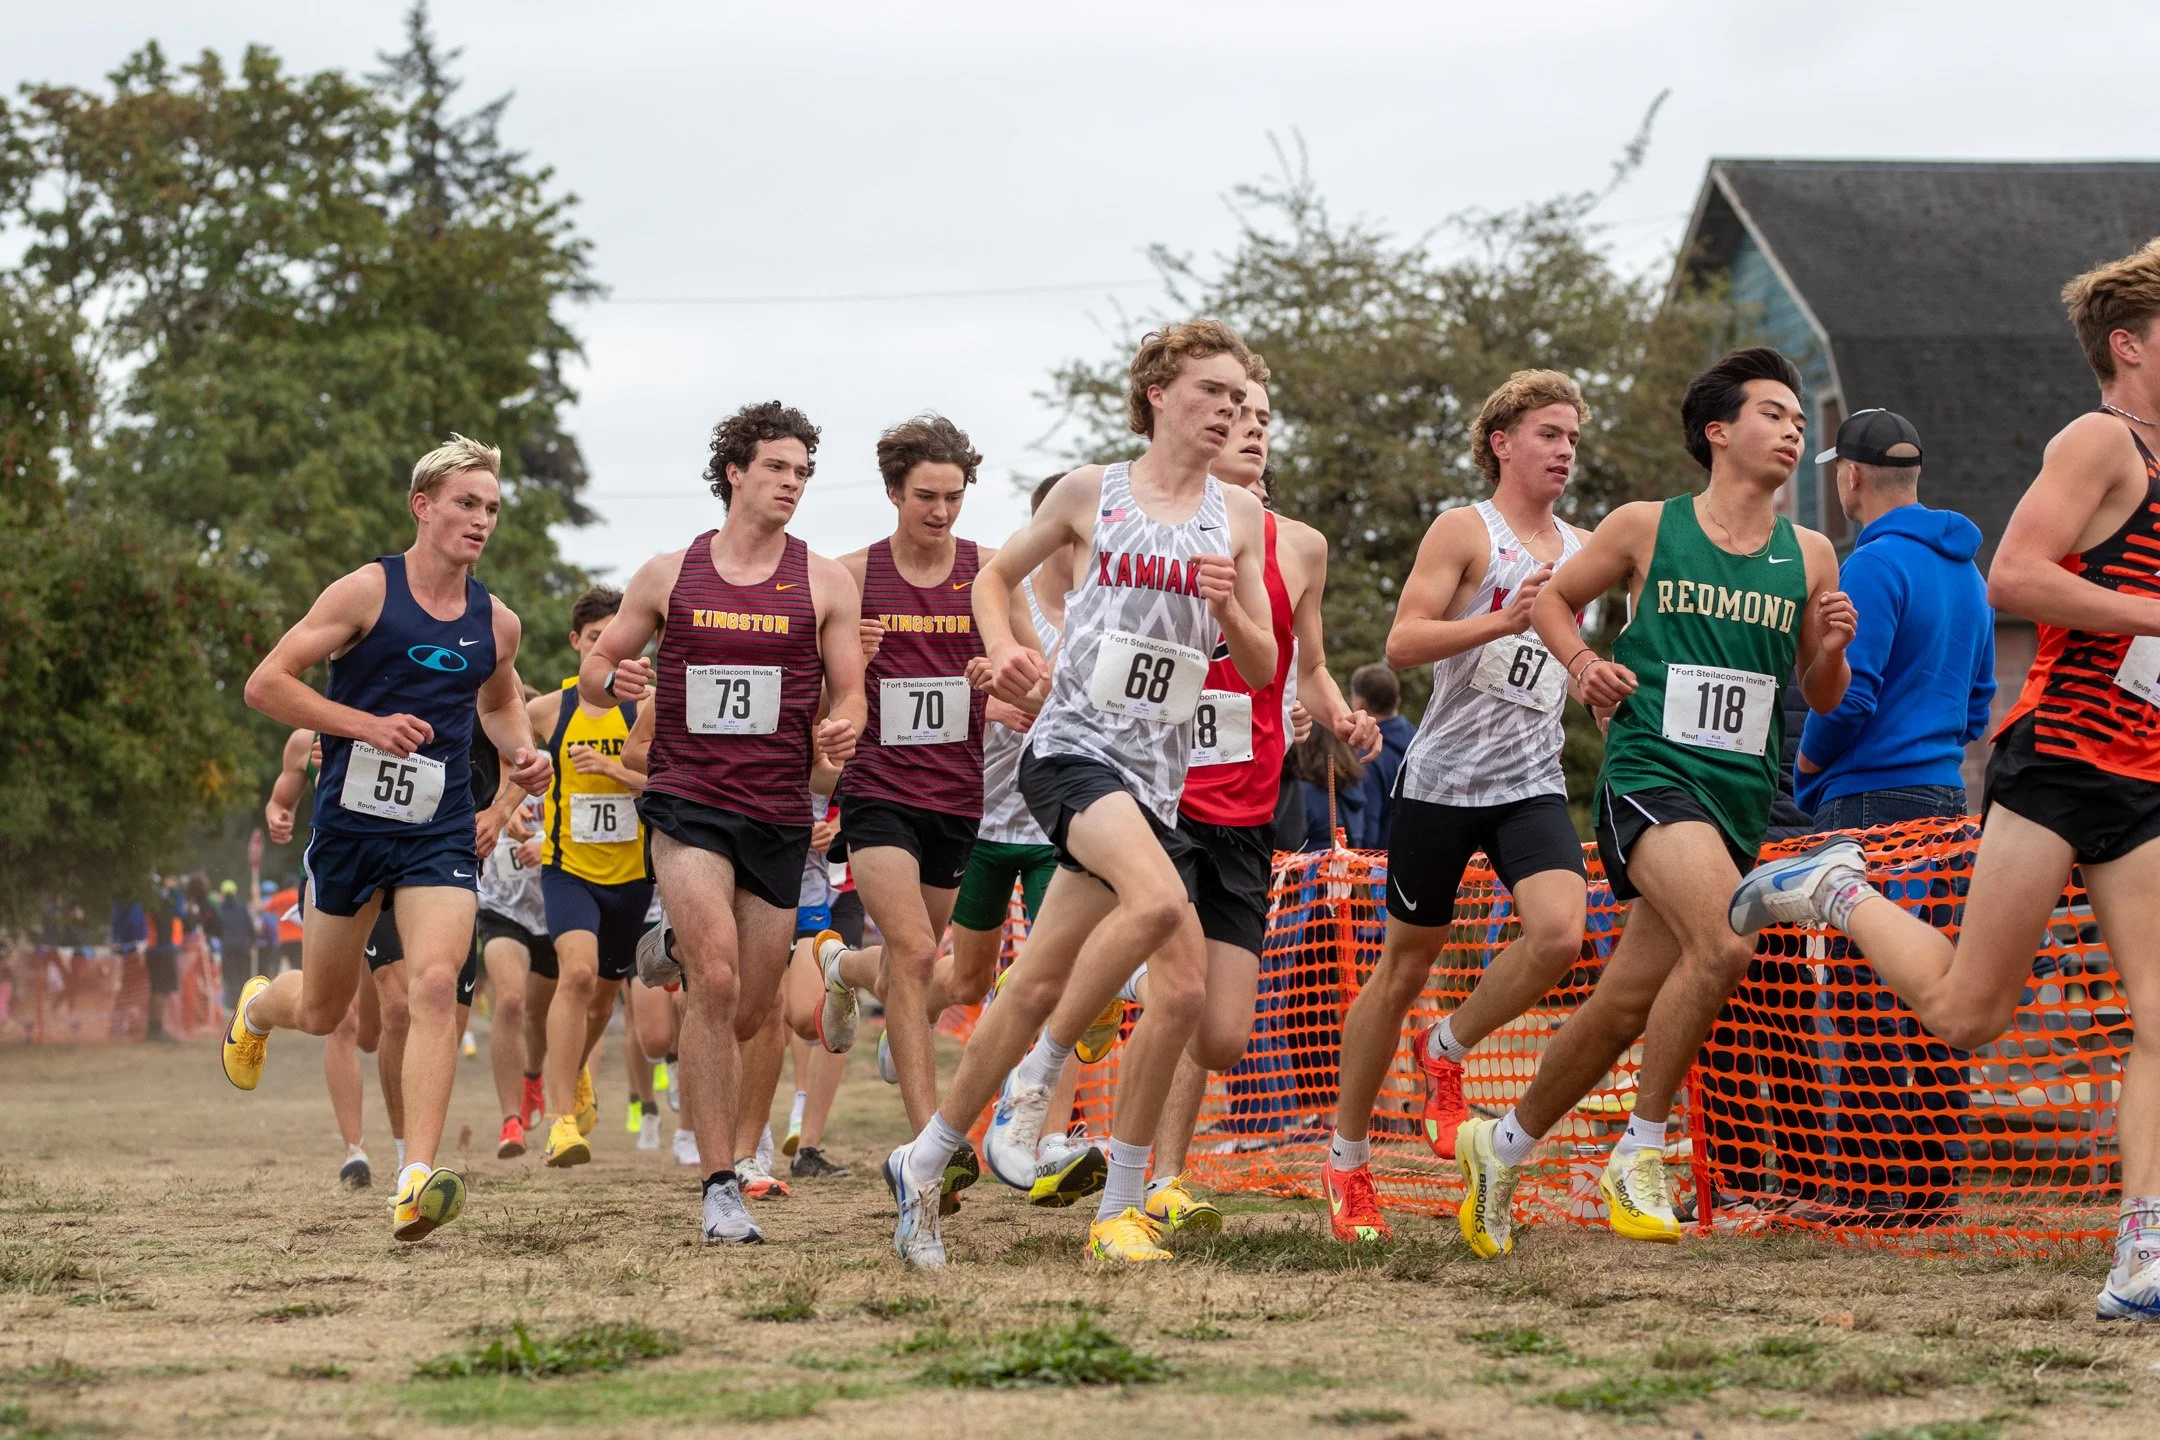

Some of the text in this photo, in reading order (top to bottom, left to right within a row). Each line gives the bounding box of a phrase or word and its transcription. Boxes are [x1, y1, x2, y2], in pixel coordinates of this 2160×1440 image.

[1098, 551, 1206, 600] KAMIAK
[1657, 579, 1797, 634] REDMOND
[692, 609, 790, 635] KINGSTON
[879, 614, 970, 634] KINGSTON
[1109, 634, 1200, 661] Fort Steilacoom Invite
[1124, 652, 1175, 704] 68
[1507, 644, 1549, 691] 67
[1675, 668, 1766, 687] Fort Steilacoom Invite
[715, 678, 751, 719] 73
[886, 681, 901, 689] Fort
[1487, 683, 1505, 694] Rout
[2133, 679, 2151, 695] Route
[908, 690, 944, 730] 70
[1697, 681, 1746, 734] 118
[1681, 731, 1699, 740] Rout
[359, 745, 375, 754] Fort
[419, 758, 438, 769] Invite
[373, 759, 418, 806] 55
[357, 801, 377, 811] Route
[590, 803, 617, 832] 76
[1035, 1161, 1057, 1178] OOKS
[1475, 1173, 1487, 1234] BROOKS
[1614, 1179, 1646, 1218] BROOKS
